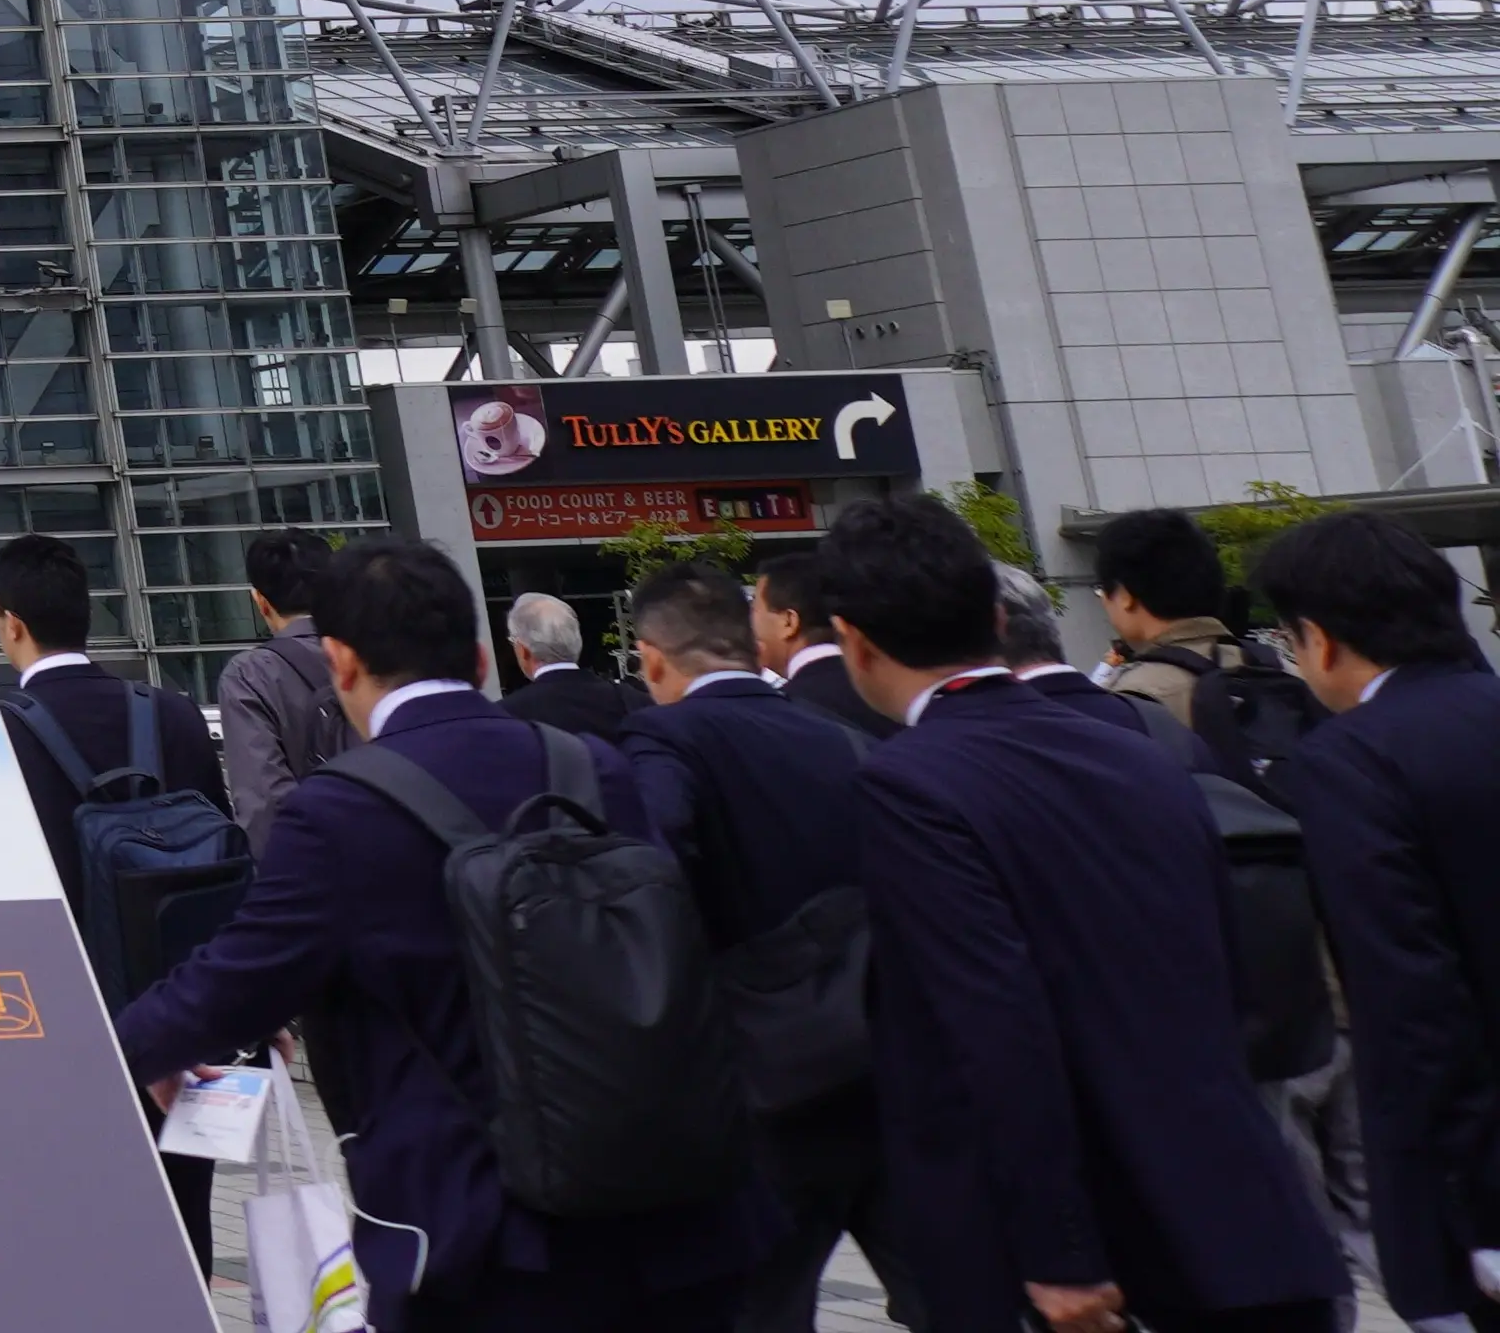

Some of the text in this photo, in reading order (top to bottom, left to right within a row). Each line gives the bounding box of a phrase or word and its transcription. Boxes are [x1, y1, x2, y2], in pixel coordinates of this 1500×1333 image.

[688, 417, 822, 445] GALLERY
[506, 490, 687, 510] FOOD COURT & BEER
